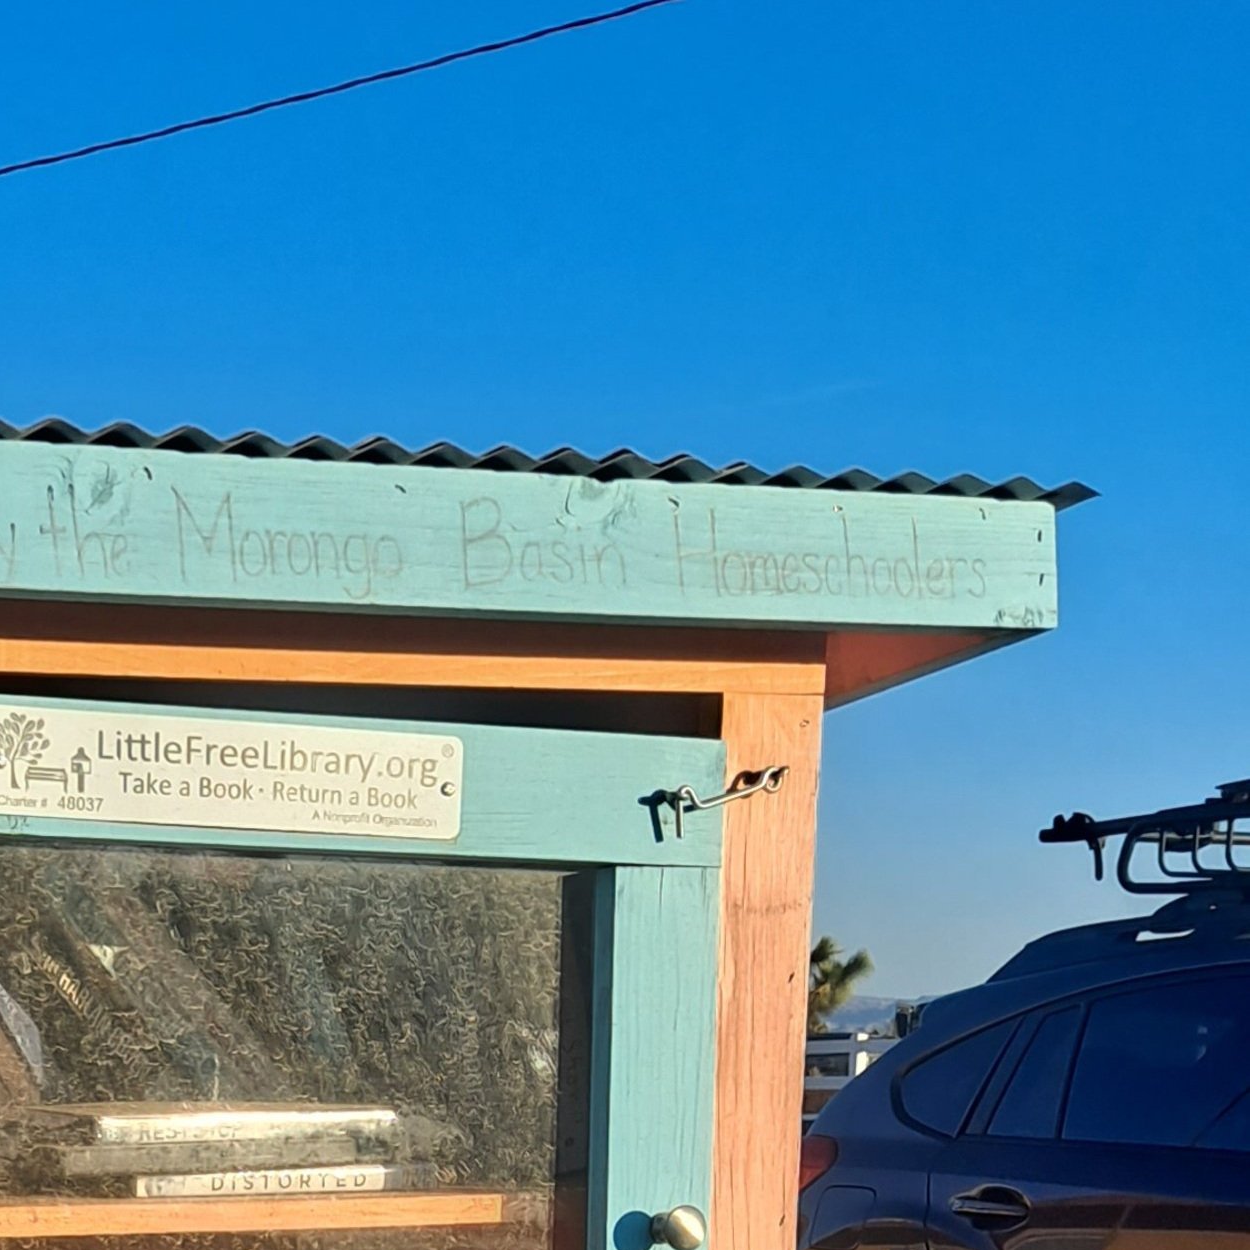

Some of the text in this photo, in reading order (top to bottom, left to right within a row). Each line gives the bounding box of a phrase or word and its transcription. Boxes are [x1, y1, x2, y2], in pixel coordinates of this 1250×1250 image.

[40, 483, 129, 579] the
[170, 485, 403, 600] Morongo
[458, 496, 628, 591] Basin
[671, 506, 987, 601] Homeschoolers
[97, 729, 439, 788] LittleFreeLibrary.org
[57, 795, 105, 813] 48037
[118, 771, 418, 810] Take a Book Return a Book
[312, 810, 439, 828] A Nonprofit Organization
[211, 1171, 367, 1192] DISTORTED
